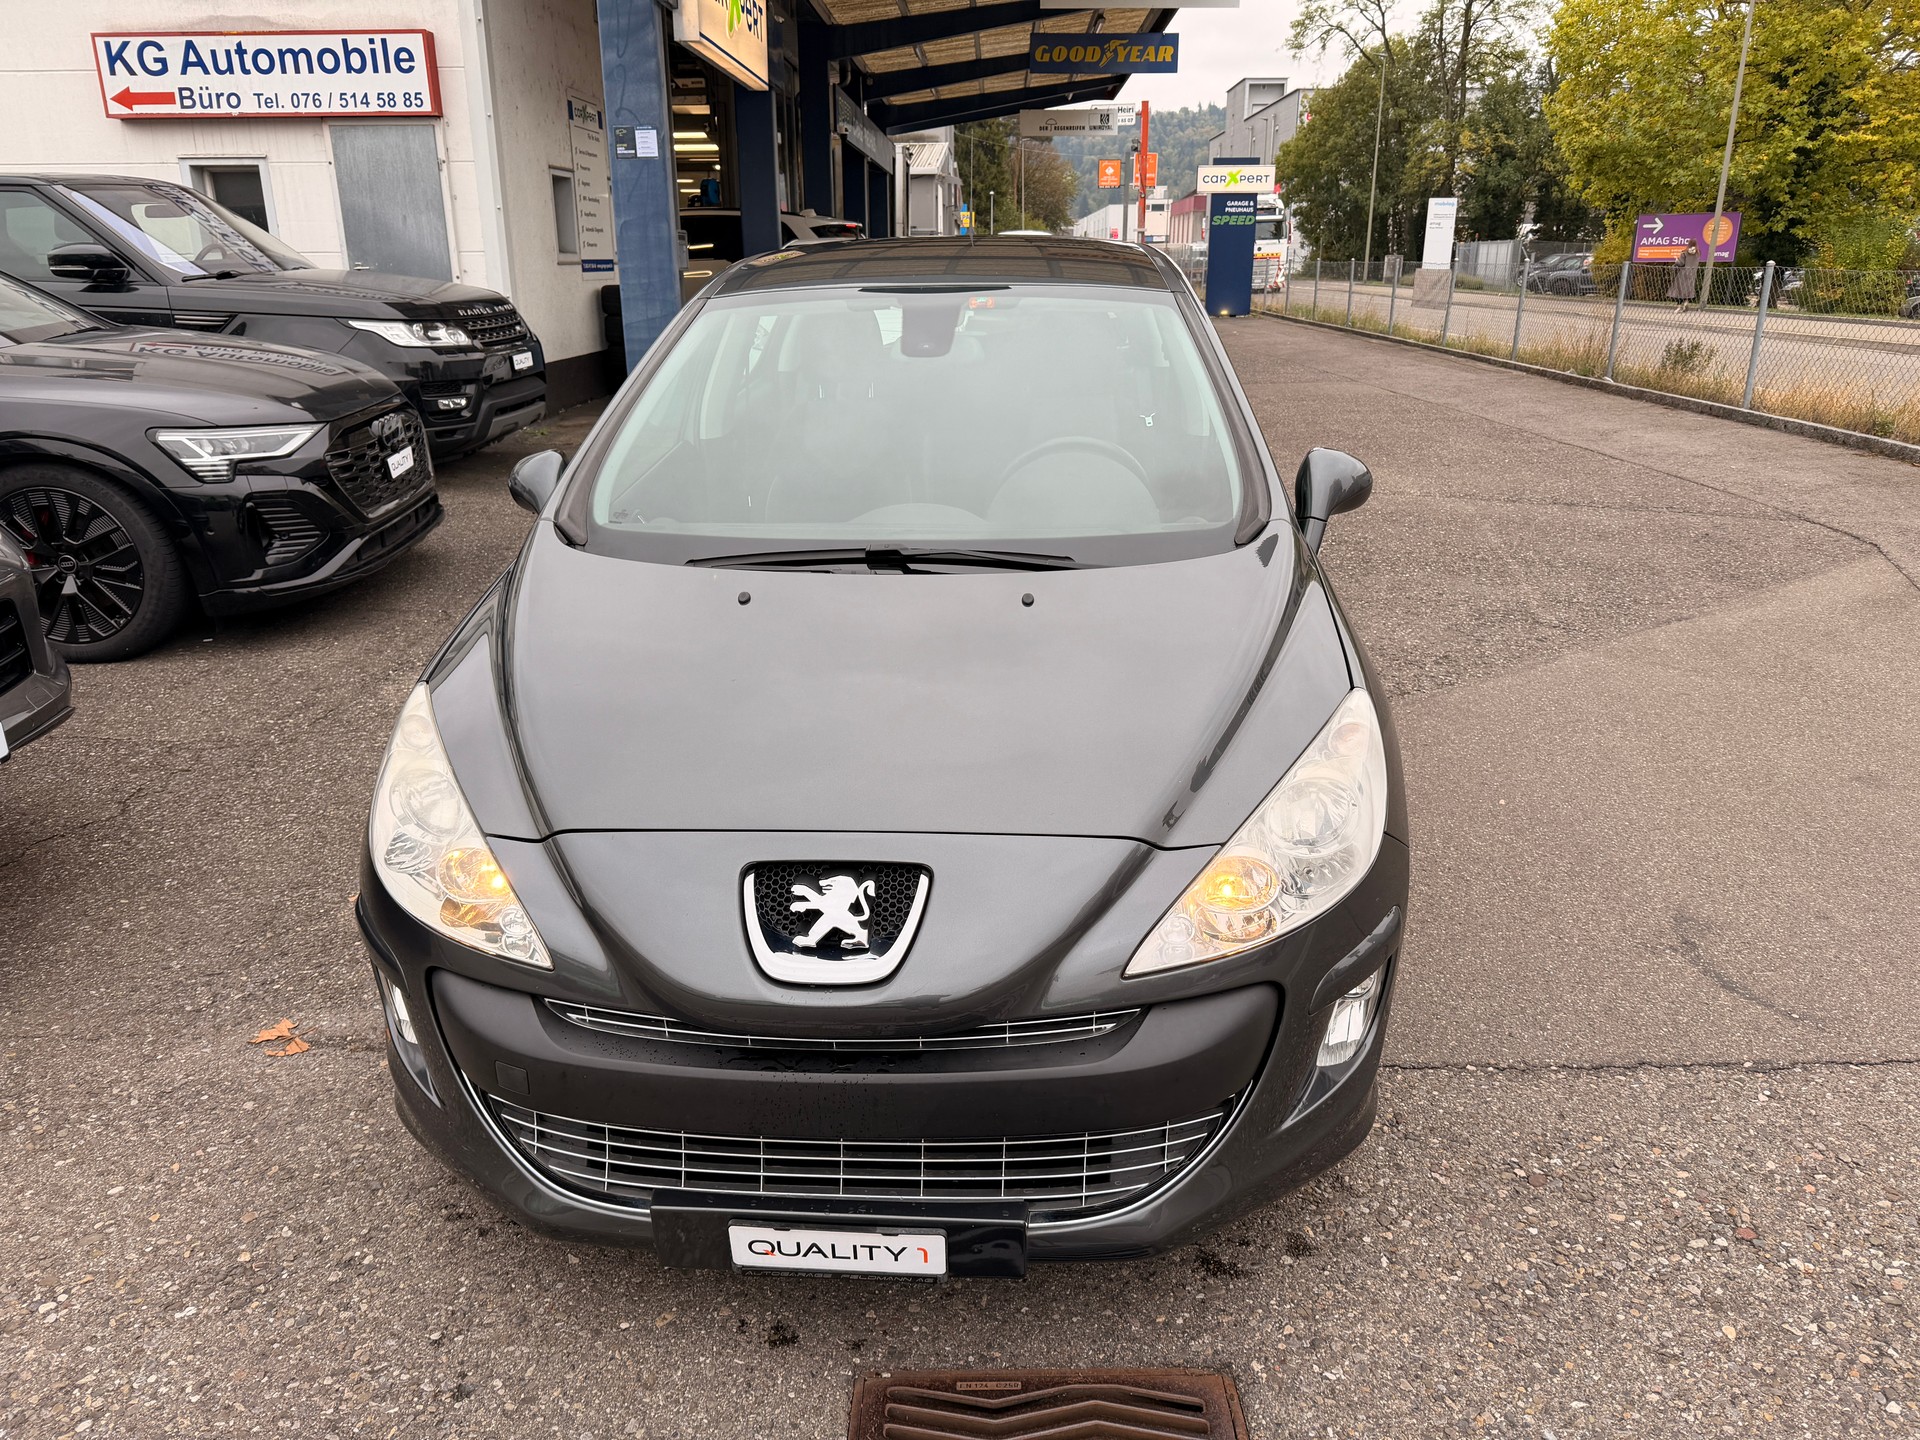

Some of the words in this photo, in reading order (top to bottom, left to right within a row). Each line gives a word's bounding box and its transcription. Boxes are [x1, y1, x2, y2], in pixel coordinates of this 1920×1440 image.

[103, 39, 169, 76] KG
[180, 37, 416, 75] Automobile
[177, 86, 242, 110] Büro
[252, 92, 285, 109] Tel.
[290, 92, 322, 109] 076
[327, 92, 333, 109] /
[338, 92, 371, 109] 514
[376, 92, 397, 109] 58
[403, 91, 425, 109] 85
[1211, 215, 1256, 226] SPEED
[1640, 237, 1670, 245] AMAG
[1671, 236, 1691, 245] Sho
[747, 1239, 908, 1262] QUALITY
[916, 1247, 929, 1264] 1
[745, 1270, 833, 1279] AUTOGARAGE
[840, 1274, 913, 1282] FELDMANN
